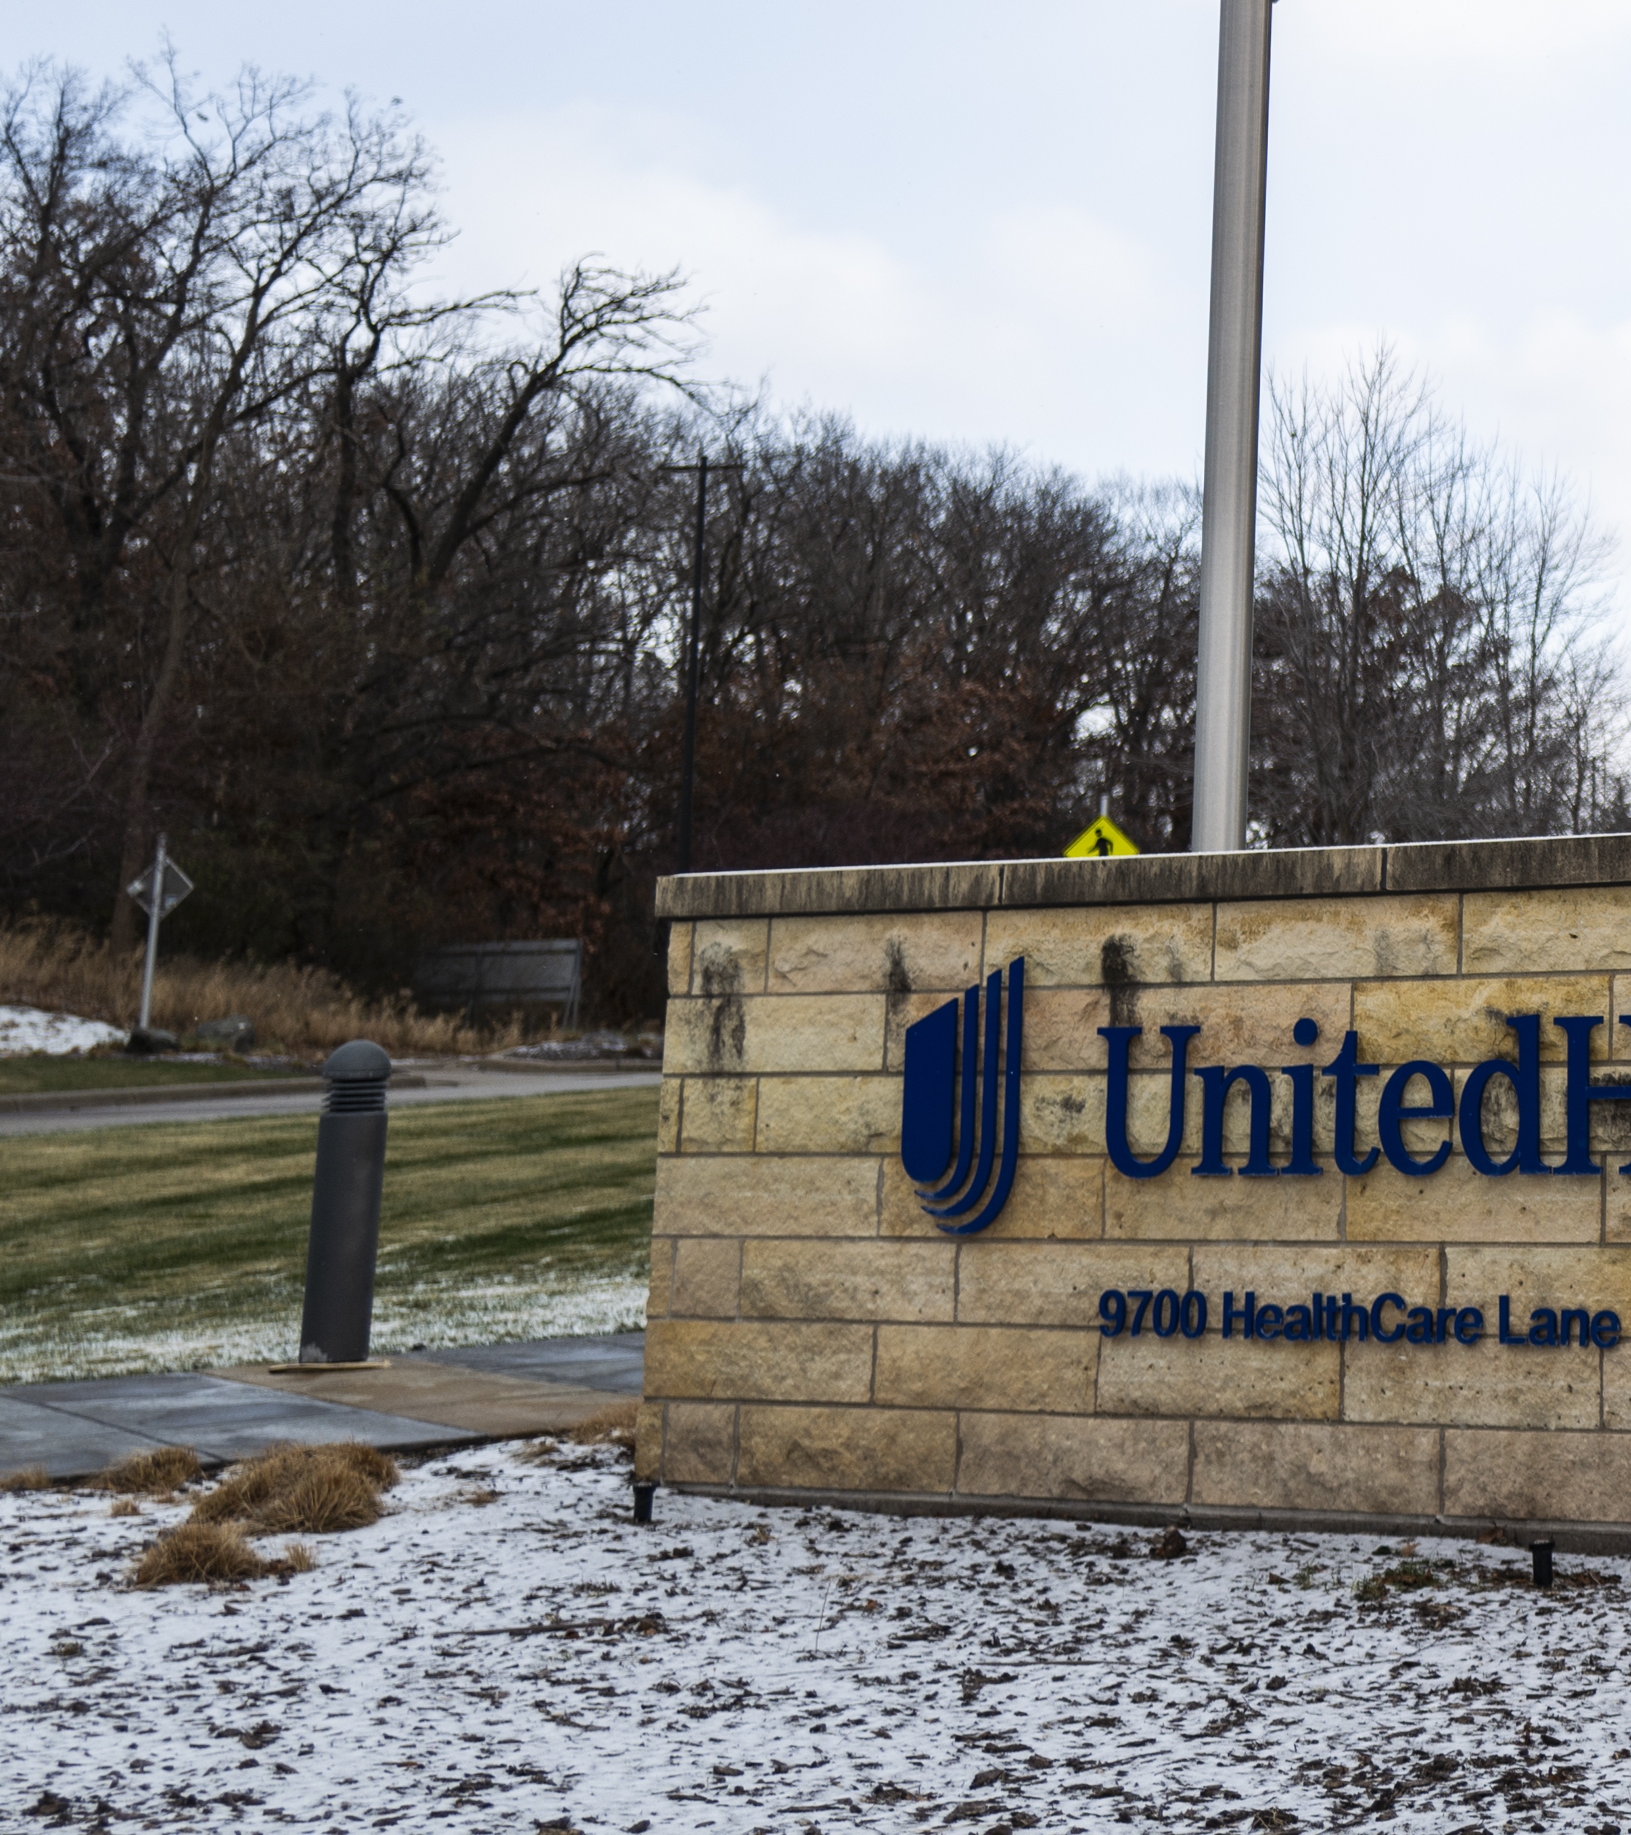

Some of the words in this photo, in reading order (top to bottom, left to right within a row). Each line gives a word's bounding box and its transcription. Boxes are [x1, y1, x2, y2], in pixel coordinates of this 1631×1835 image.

[1098, 1289, 1208, 1340] 9700
[1221, 1291, 1484, 1345] HealthCare
[1498, 1295, 1622, 1349] Lane
